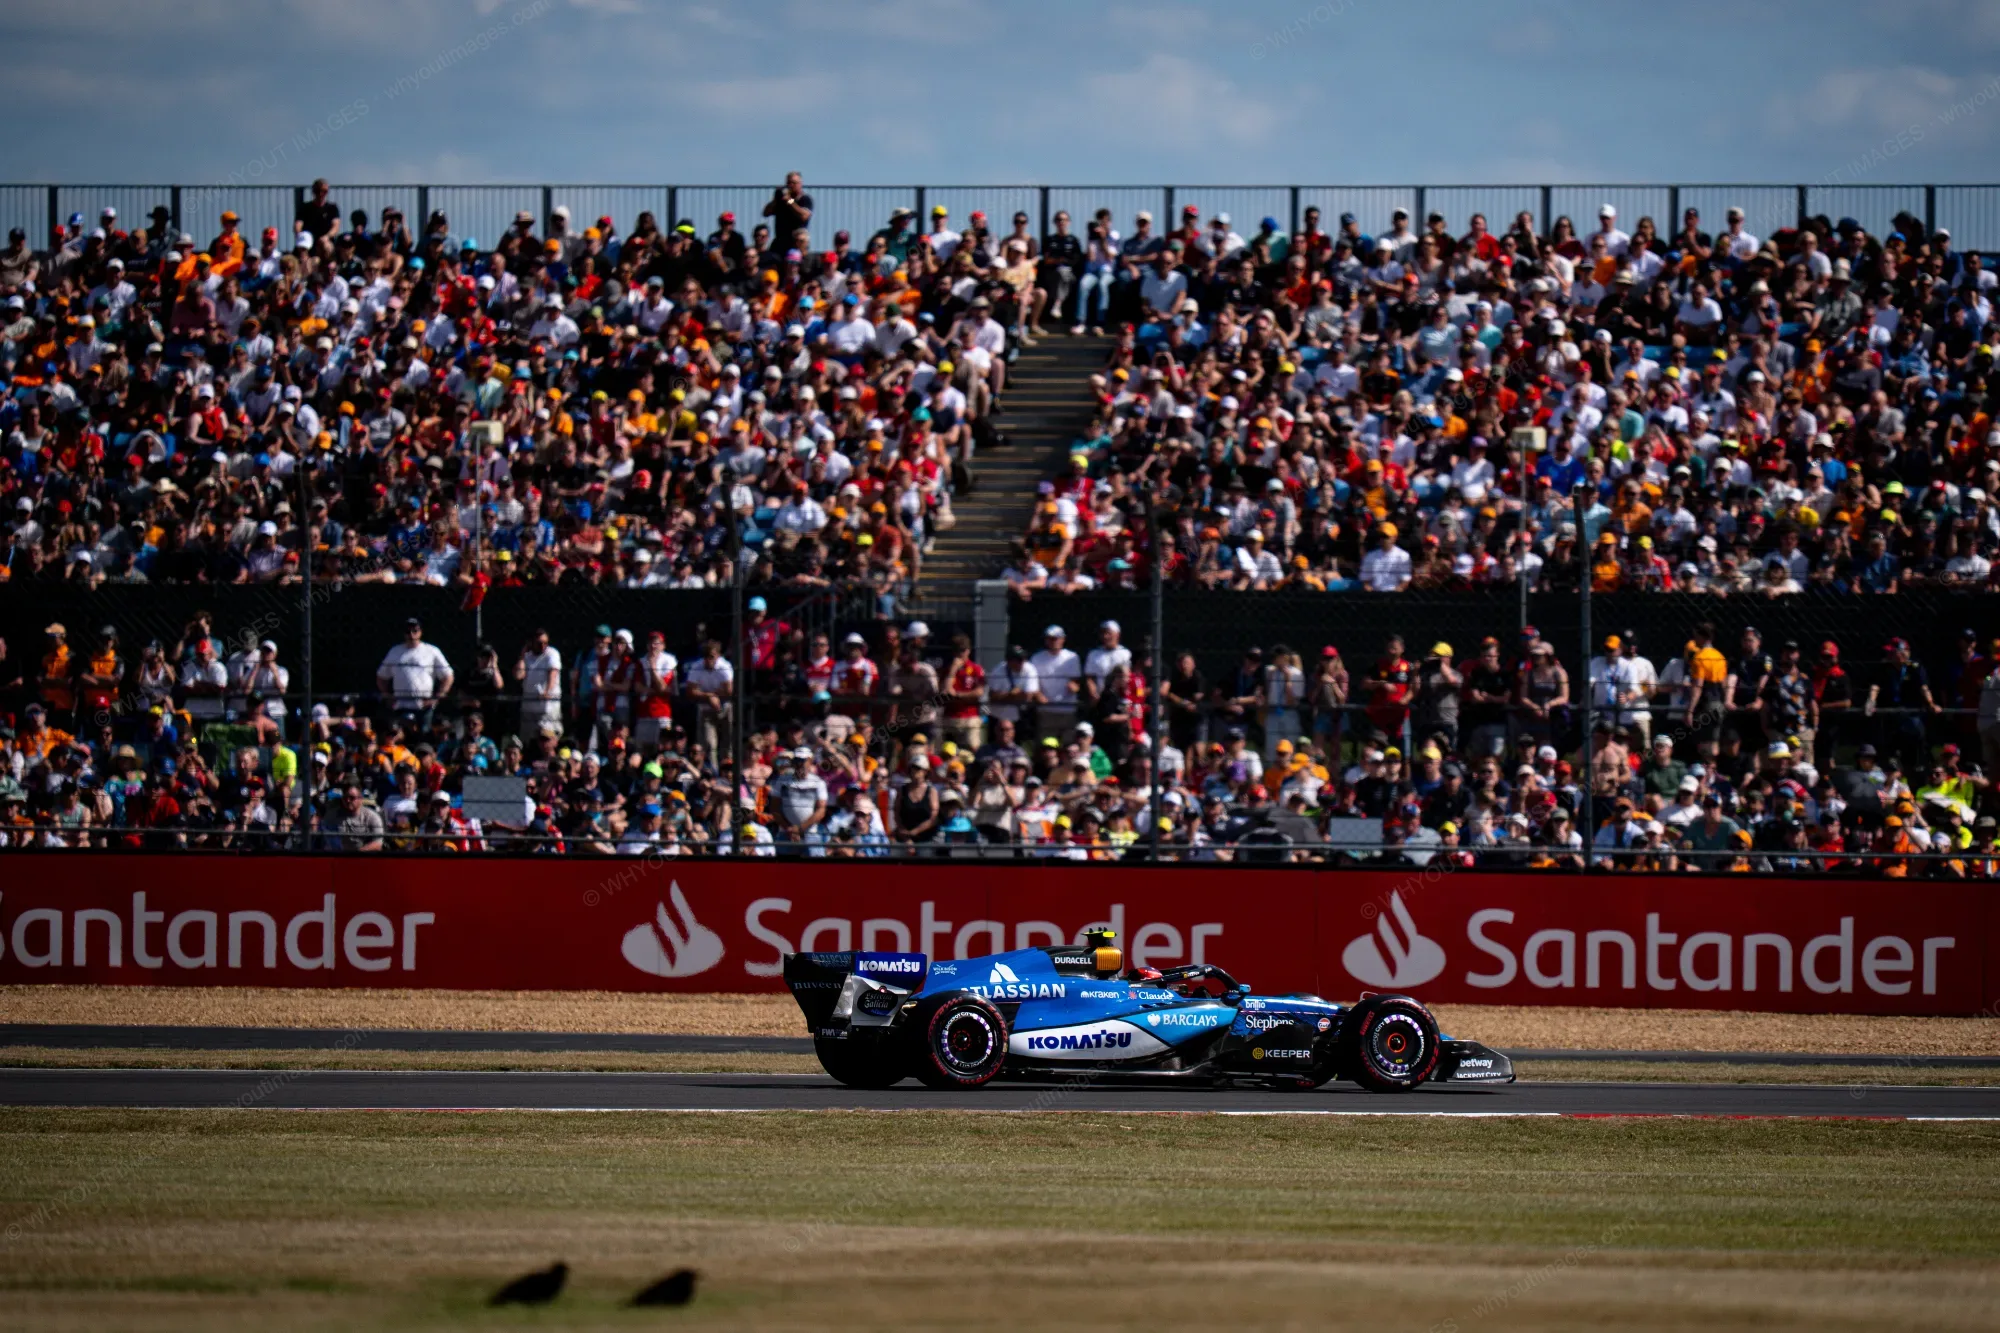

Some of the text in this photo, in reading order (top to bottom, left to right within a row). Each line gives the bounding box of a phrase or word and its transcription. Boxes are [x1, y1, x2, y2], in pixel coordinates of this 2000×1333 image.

[0, 890, 436, 971] antander
[1465, 908, 1956, 996] Santander
[859, 958, 920, 973] KOMATSU
[1054, 956, 1092, 965] DURACELL
[961, 983, 1066, 999] TLASSIAN
[1163, 1014, 1218, 1027] BARCLAYS
[1027, 1029, 1132, 1050] KOMATSU
[1265, 1049, 1311, 1059] KEEPER
[1460, 1058, 1493, 1069] betway
